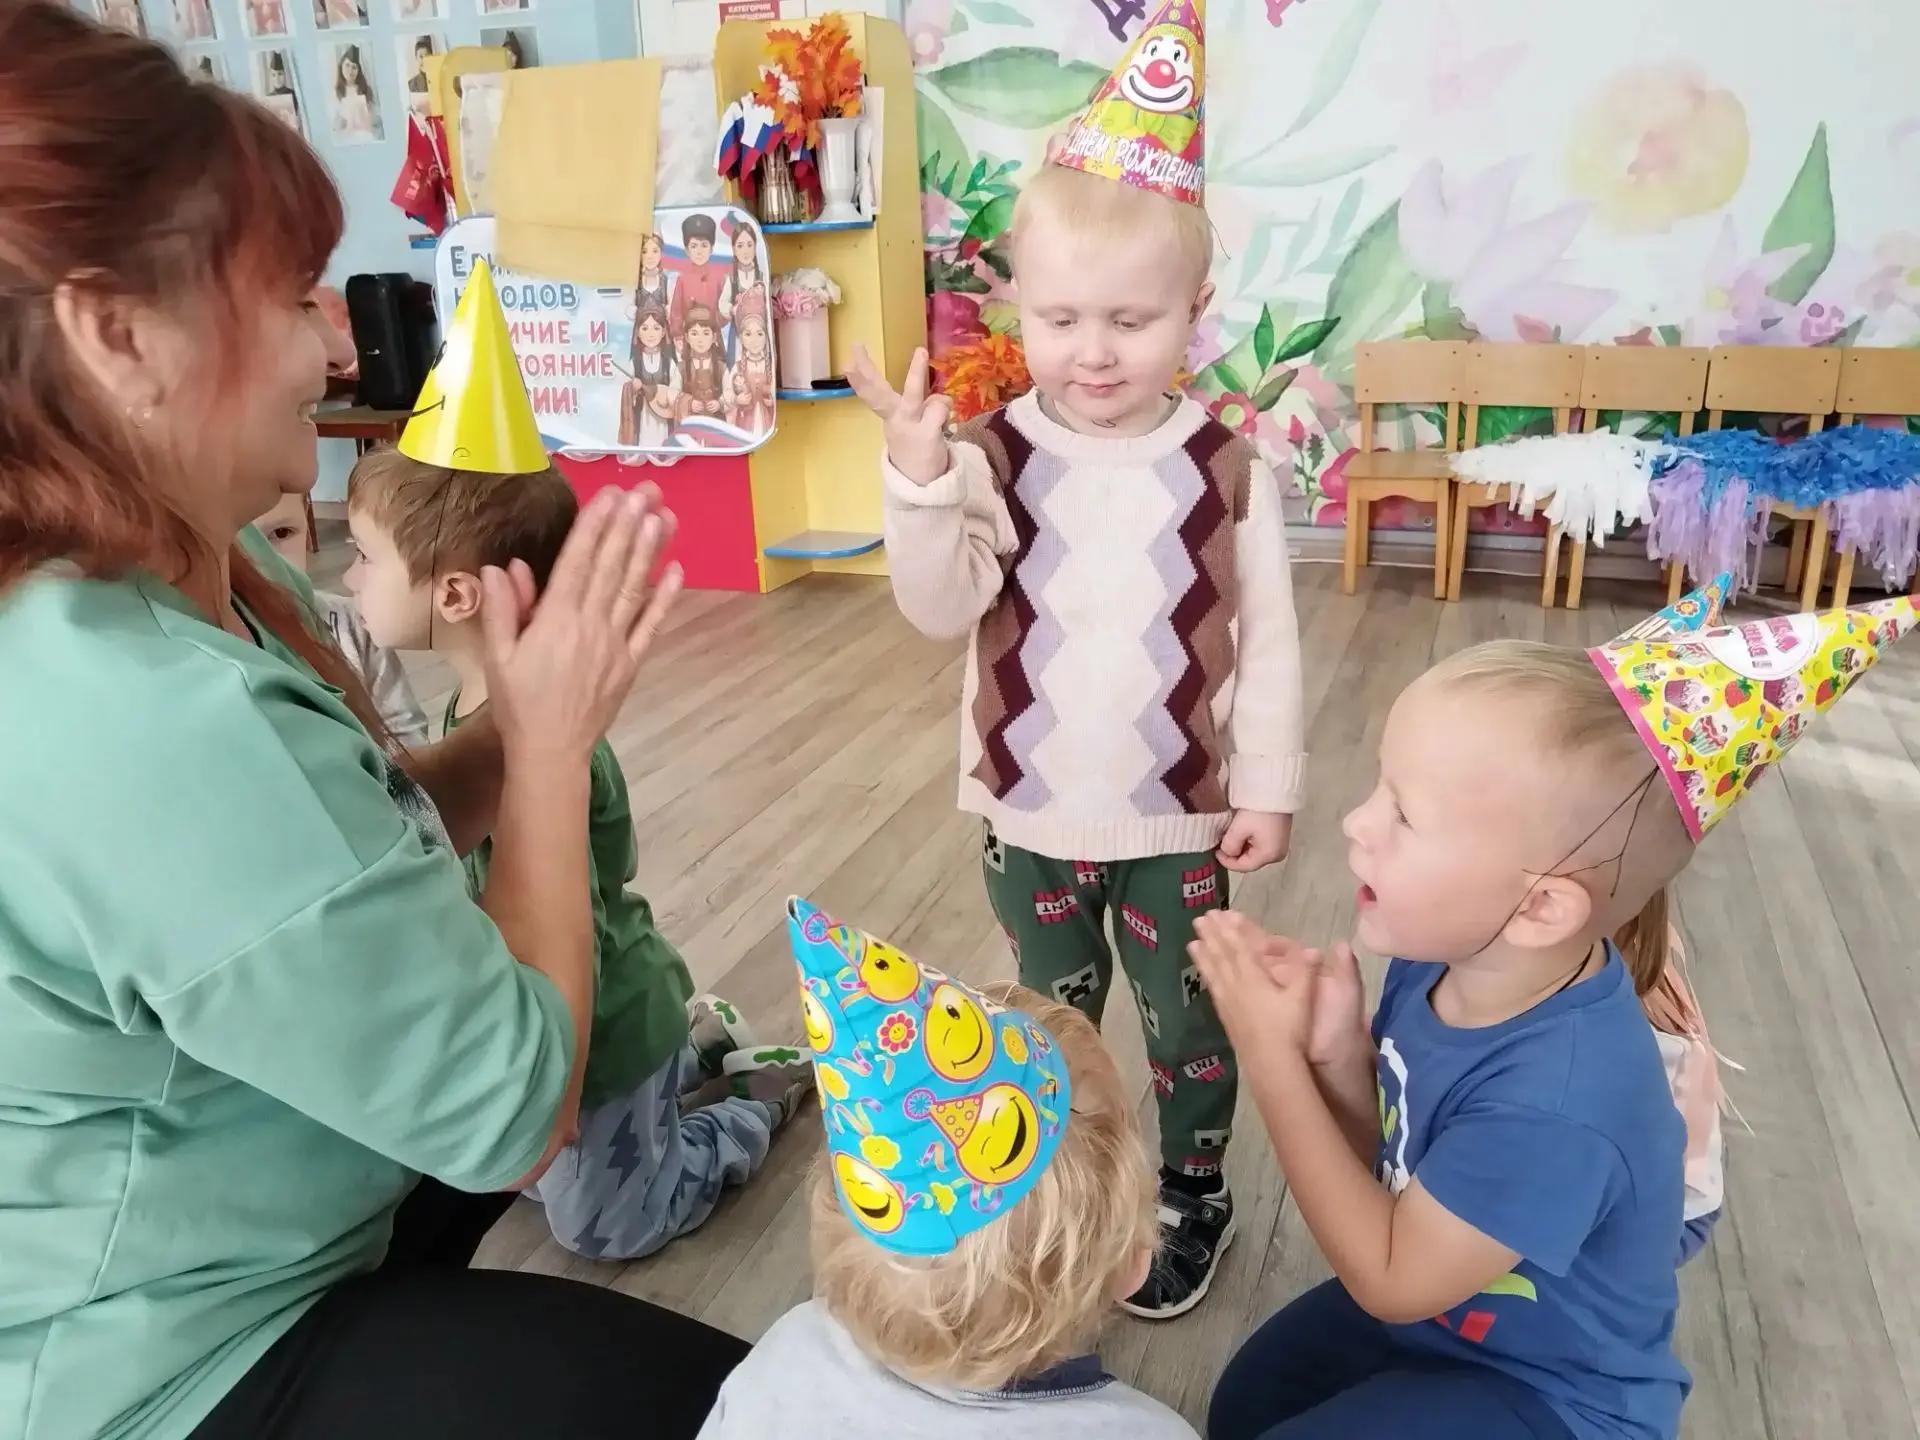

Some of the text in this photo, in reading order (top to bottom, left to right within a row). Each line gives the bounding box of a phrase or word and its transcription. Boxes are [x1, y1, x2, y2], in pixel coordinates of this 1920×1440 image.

[1112, 138, 1203, 193] РОЖДЕНИЯ
[508, 320, 606, 345] ИЧИЕ И
[516, 353, 614, 377] ОЯНИЕ
[1188, 878, 1214, 895] TNT
[1042, 897, 1072, 912] TNT
[1127, 913, 1153, 937] TNT
[1189, 1057, 1215, 1075] TNT
[1191, 1165, 1214, 1177] TN
